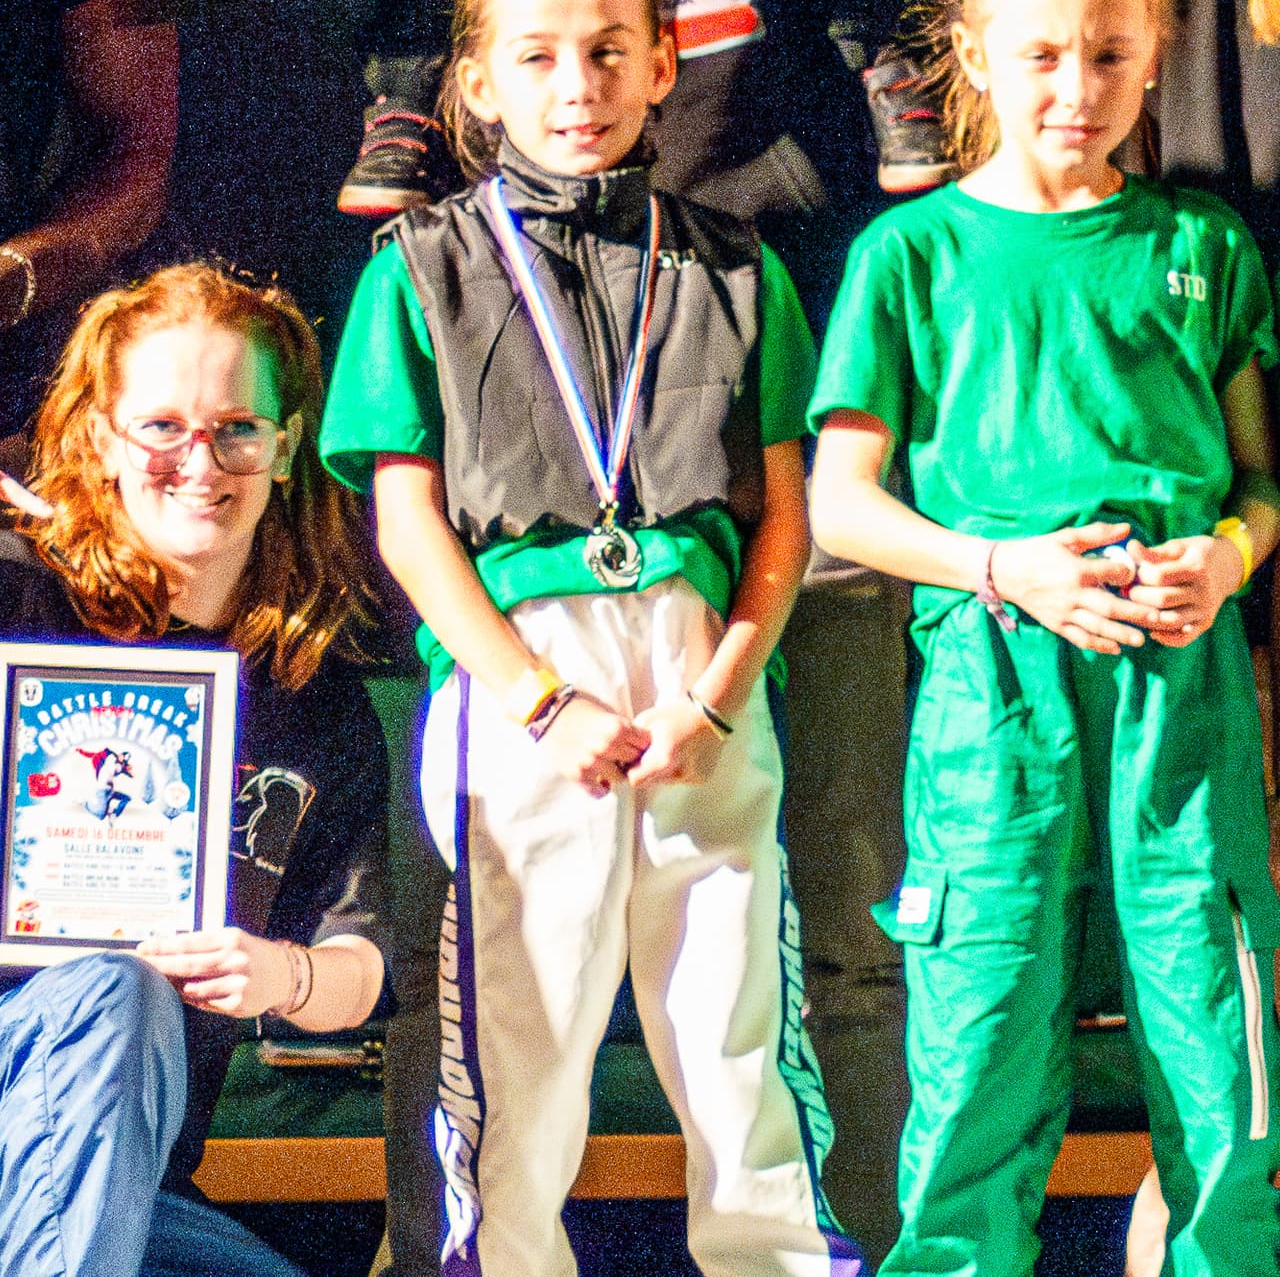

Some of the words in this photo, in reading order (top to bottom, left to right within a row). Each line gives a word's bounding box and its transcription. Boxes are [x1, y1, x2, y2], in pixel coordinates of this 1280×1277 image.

[1167, 270, 1206, 302] STD
[37, 691, 112, 725] BATTLE
[123, 692, 188, 727] BREAK
[38, 710, 183, 760] CHRISTMAS
[46, 826, 89, 839] SAMEDI
